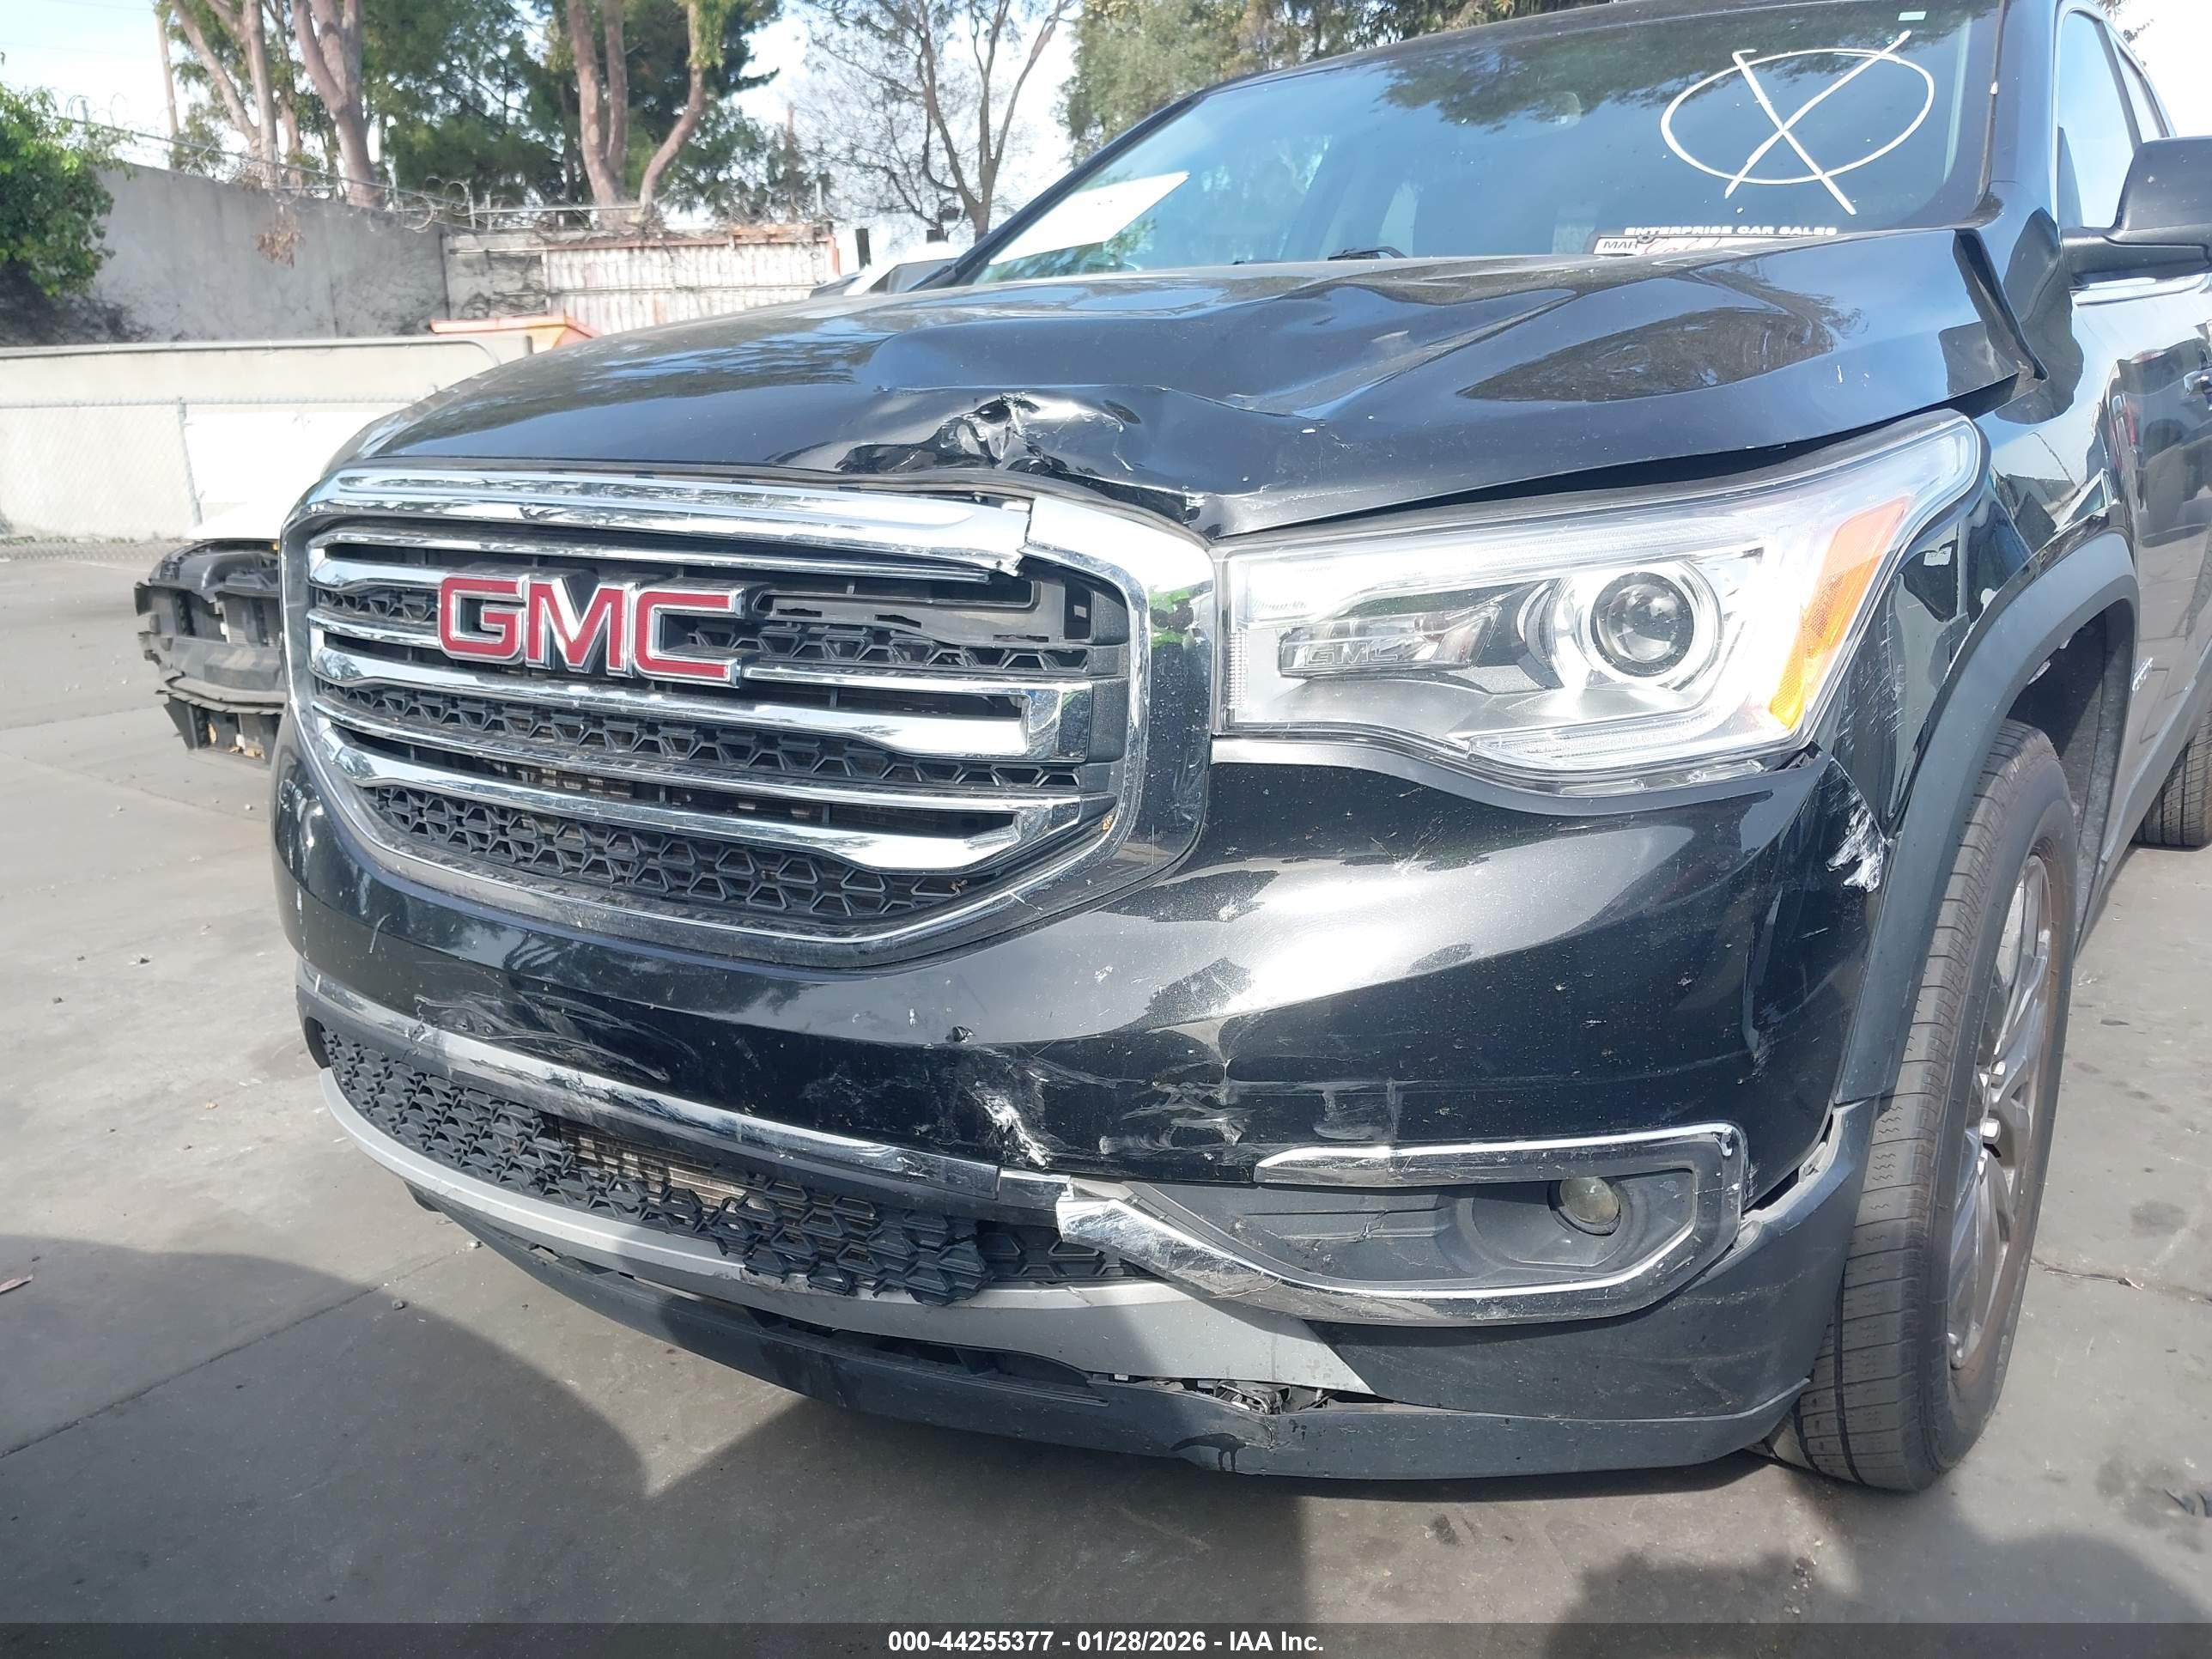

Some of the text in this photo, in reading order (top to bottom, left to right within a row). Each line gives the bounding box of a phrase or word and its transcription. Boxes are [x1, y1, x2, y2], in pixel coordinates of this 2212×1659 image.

[1624, 226, 1838, 236] ENTERPRISE CAR SALES
[437, 573, 744, 689] GMC
